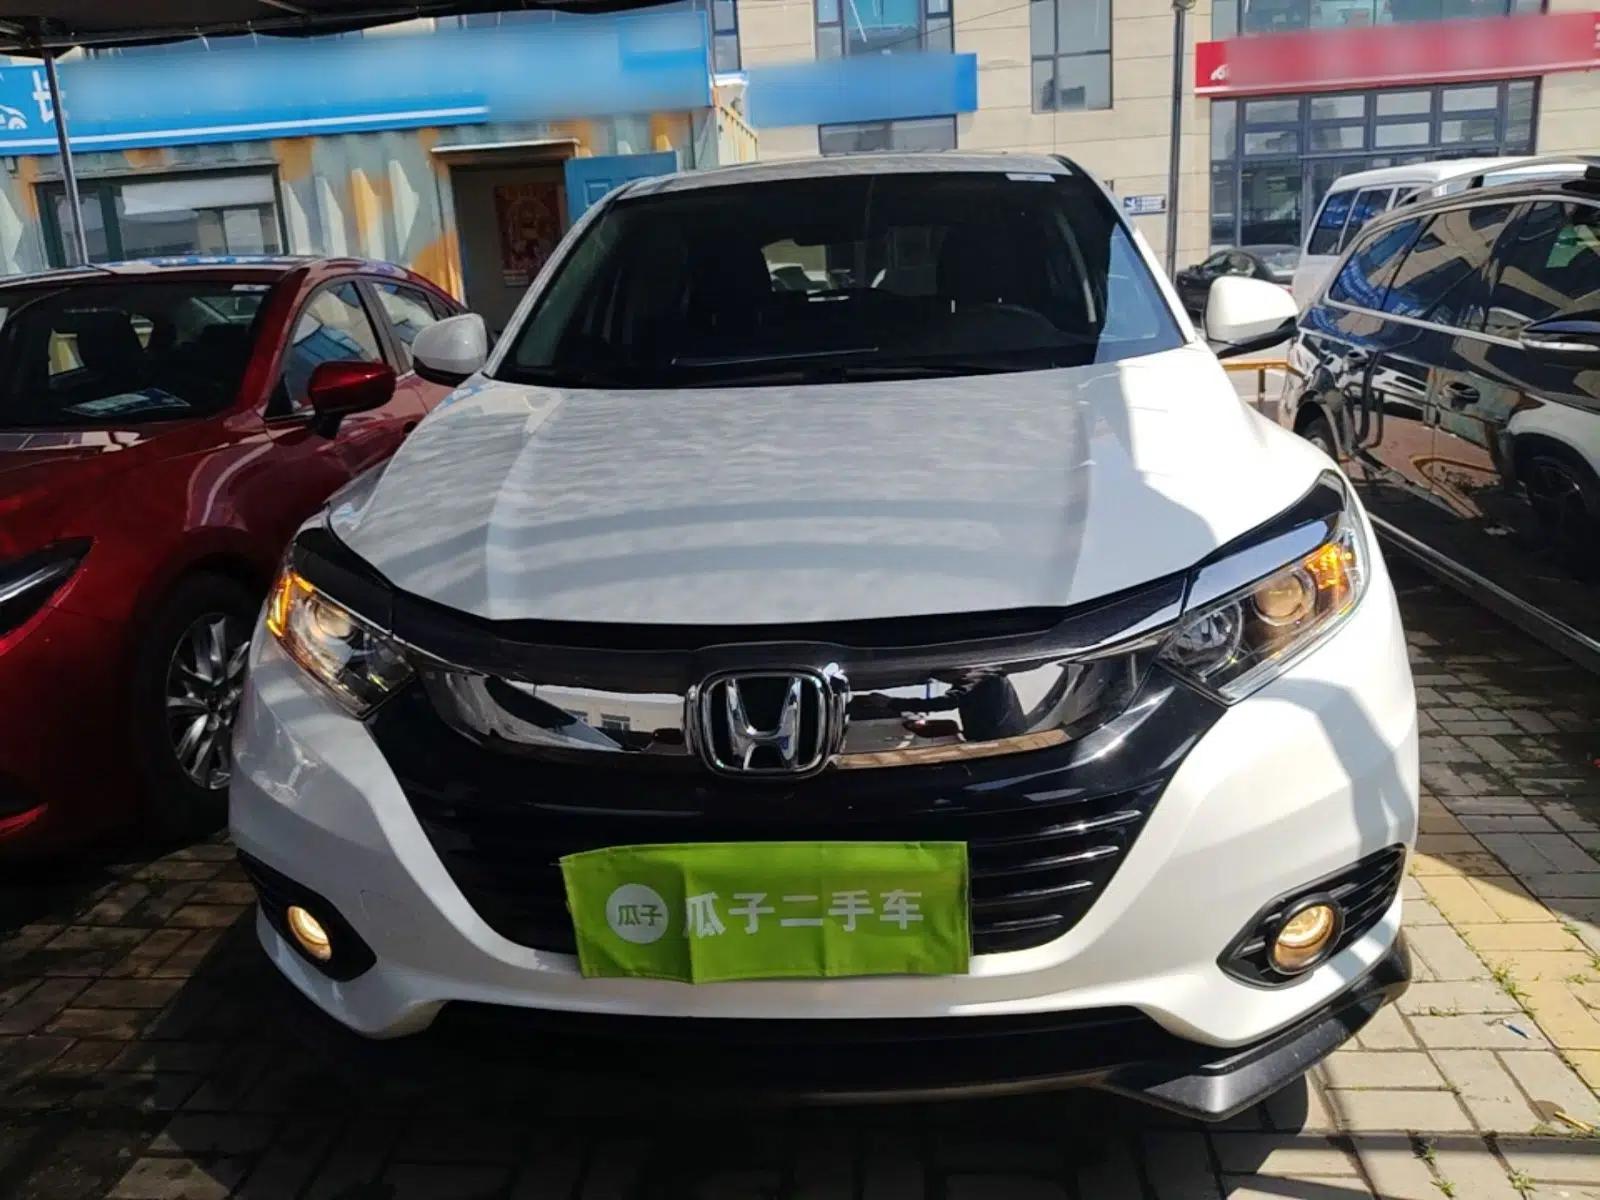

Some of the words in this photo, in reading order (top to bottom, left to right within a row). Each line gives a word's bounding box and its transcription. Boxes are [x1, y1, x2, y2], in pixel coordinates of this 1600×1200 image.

[617, 904, 663, 927] 瓜子
[682, 888, 924, 939] 瓜子二手车
